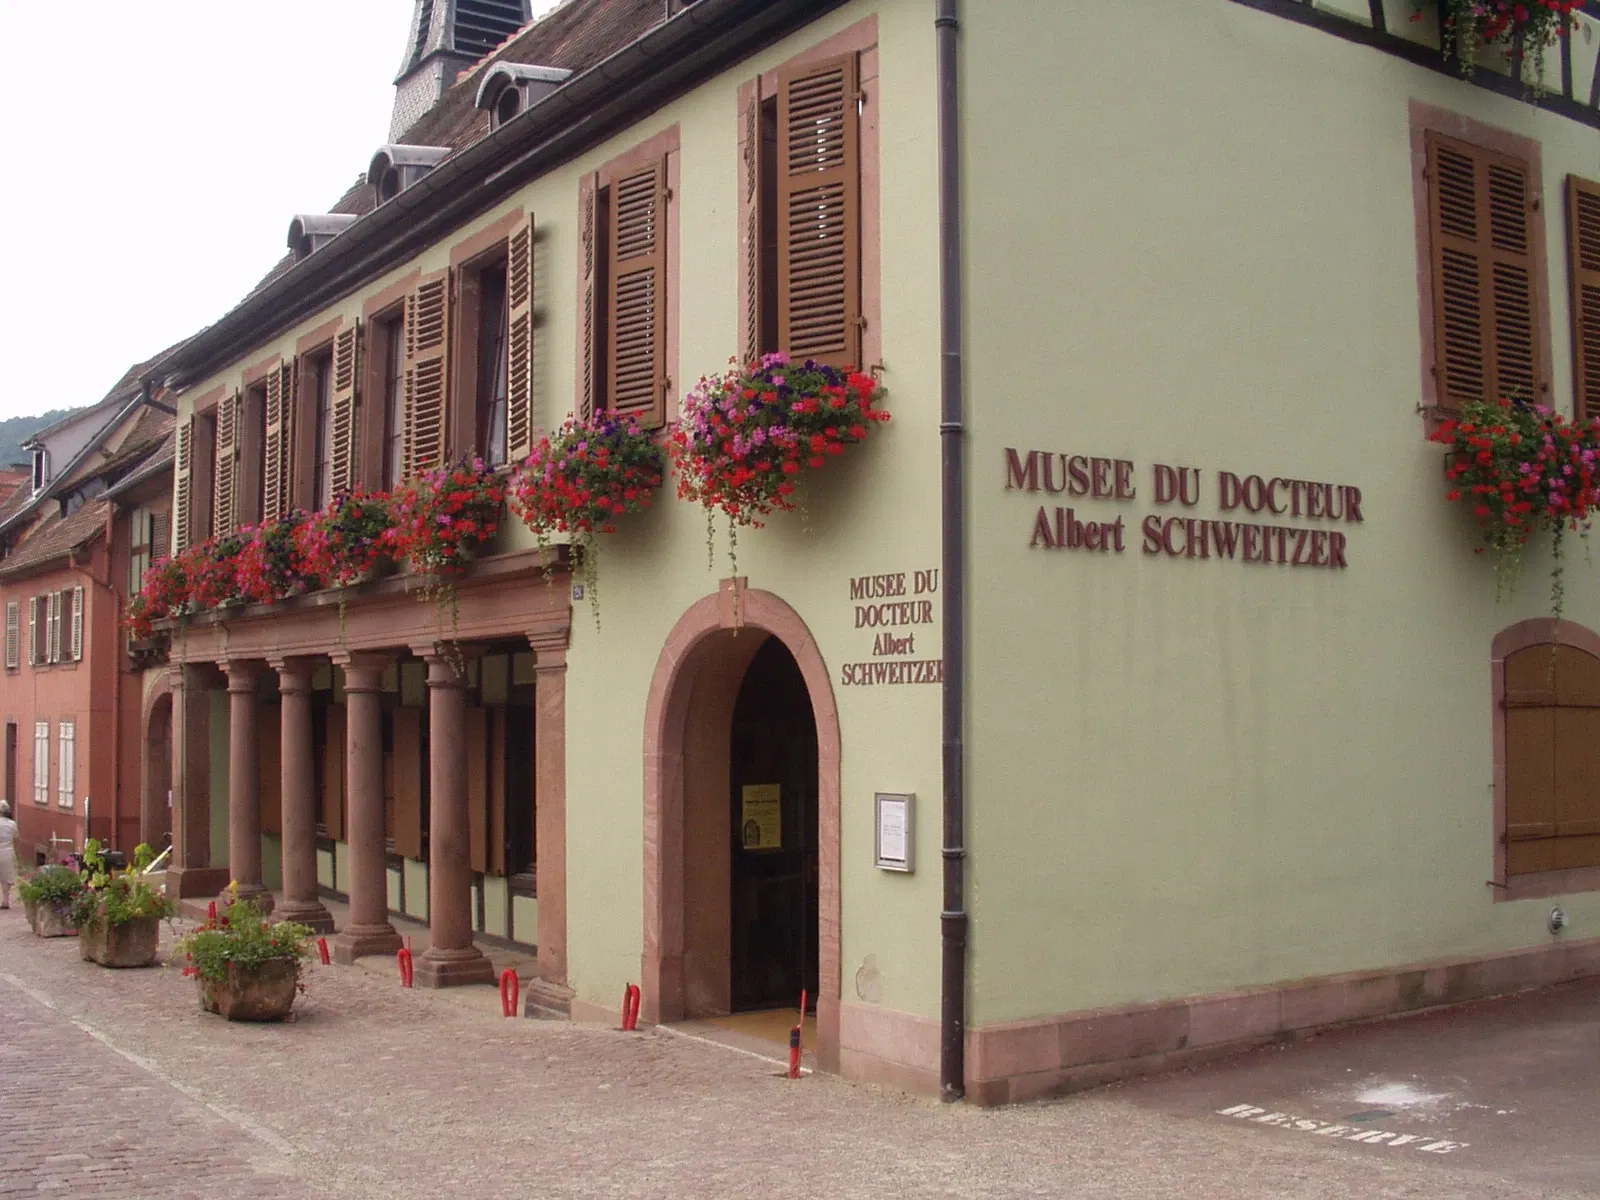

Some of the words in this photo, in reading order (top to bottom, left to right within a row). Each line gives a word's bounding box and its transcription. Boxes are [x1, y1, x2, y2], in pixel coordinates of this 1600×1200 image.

[1004, 447, 1136, 500] MUSEE
[1153, 463, 1201, 506] DU
[1218, 471, 1364, 523] DOCTEUR
[1030, 506, 1126, 553] Albert
[1142, 514, 1348, 568] SCHWEITZER
[849, 572, 906, 600] MUSEE
[914, 569, 939, 595] DU
[855, 600, 933, 628] DOCTEUR
[872, 632, 915, 656] Albert
